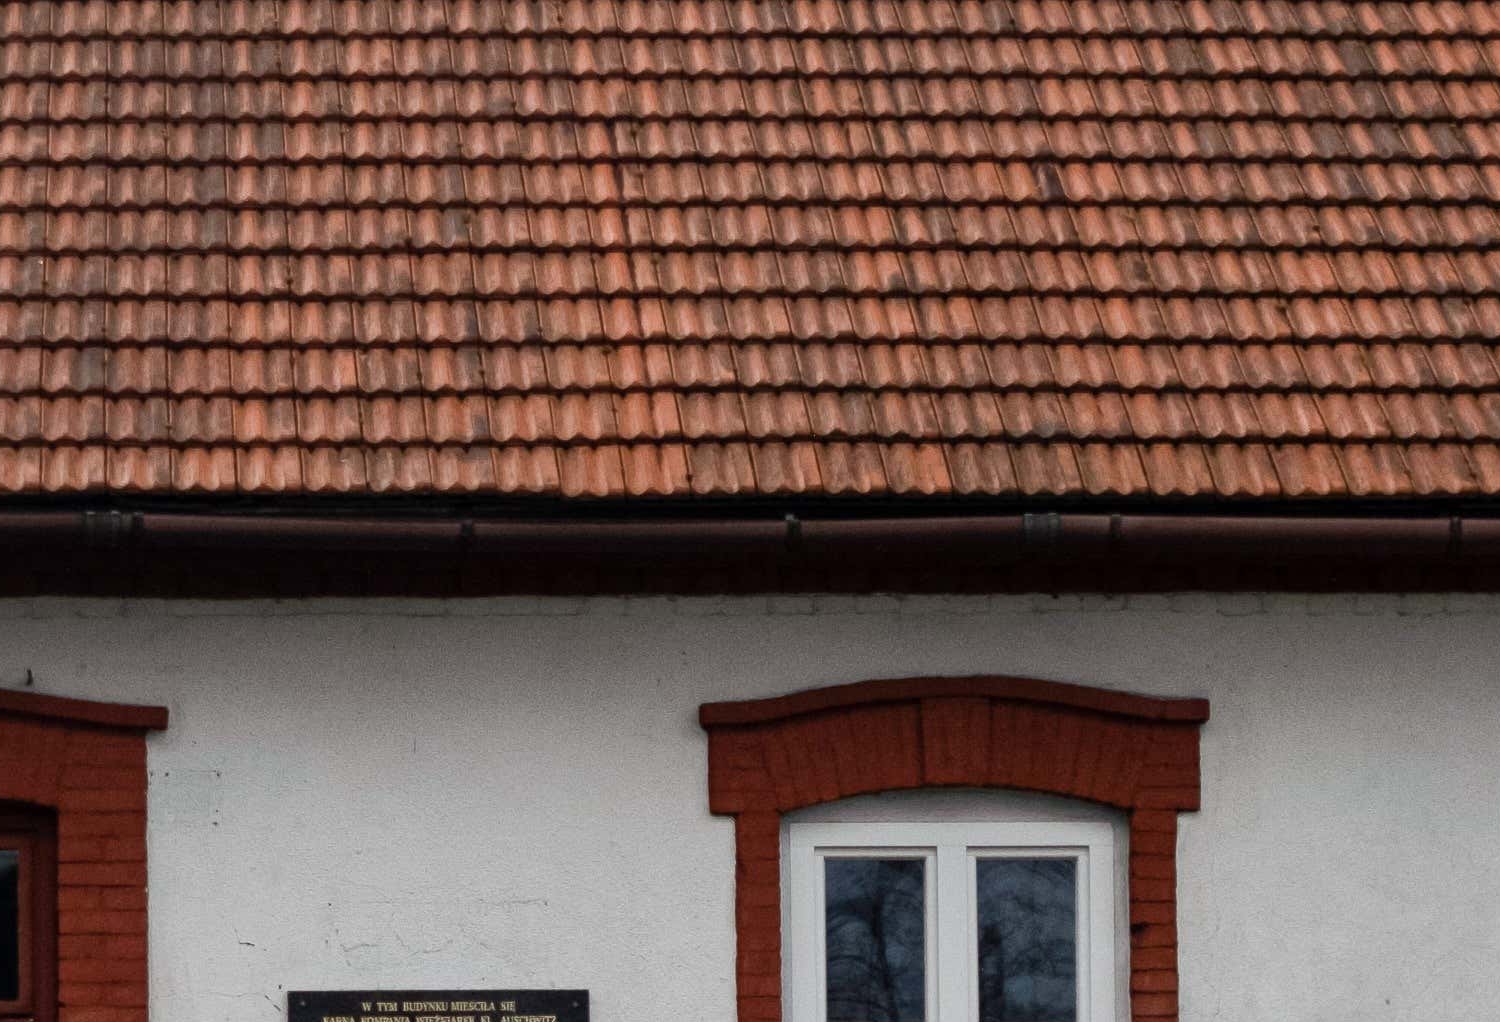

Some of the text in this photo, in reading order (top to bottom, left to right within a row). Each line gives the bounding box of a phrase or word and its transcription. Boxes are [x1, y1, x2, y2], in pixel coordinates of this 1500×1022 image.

[362, 1002, 371, 1012] W
[376, 1002, 397, 1012] TYM
[403, 1002, 448, 1012] BUDYNKU
